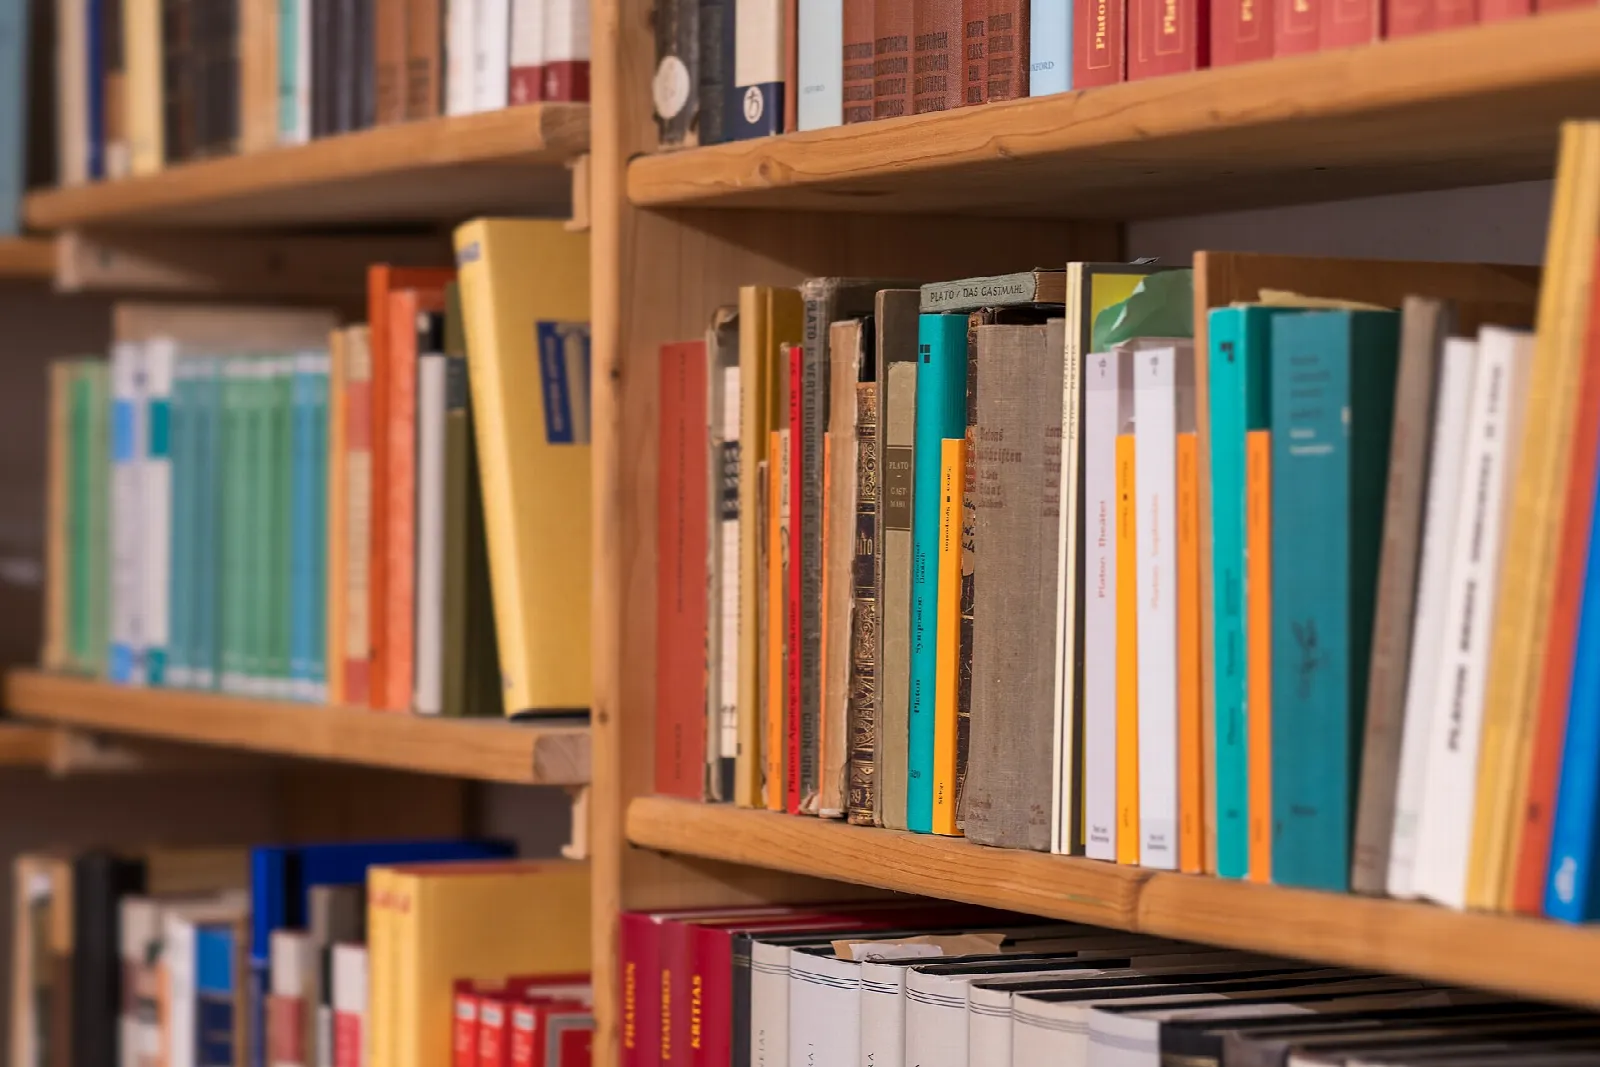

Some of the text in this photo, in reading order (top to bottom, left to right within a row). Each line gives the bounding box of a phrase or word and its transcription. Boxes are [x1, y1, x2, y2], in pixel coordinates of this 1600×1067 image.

[1031, 61, 1055, 71] XFORD
[807, 299, 817, 340] PLATO
[930, 290, 954, 302] PLATO
[963, 287, 978, 297] DAS
[981, 284, 1024, 296] GASTMAHL
[888, 461, 908, 470] PLATO
[1097, 500, 1107, 599] Platon Theätet
[789, 600, 797, 655] Sokrates
[913, 596, 924, 713] Platon Symposion
[788, 686, 797, 740] Apologie
[788, 745, 796, 793] Platons
[624, 962, 635, 1048] PHAIDON
[661, 969, 671, 1060] PHAIDROS
[691, 975, 702, 1049] KRITIAS
